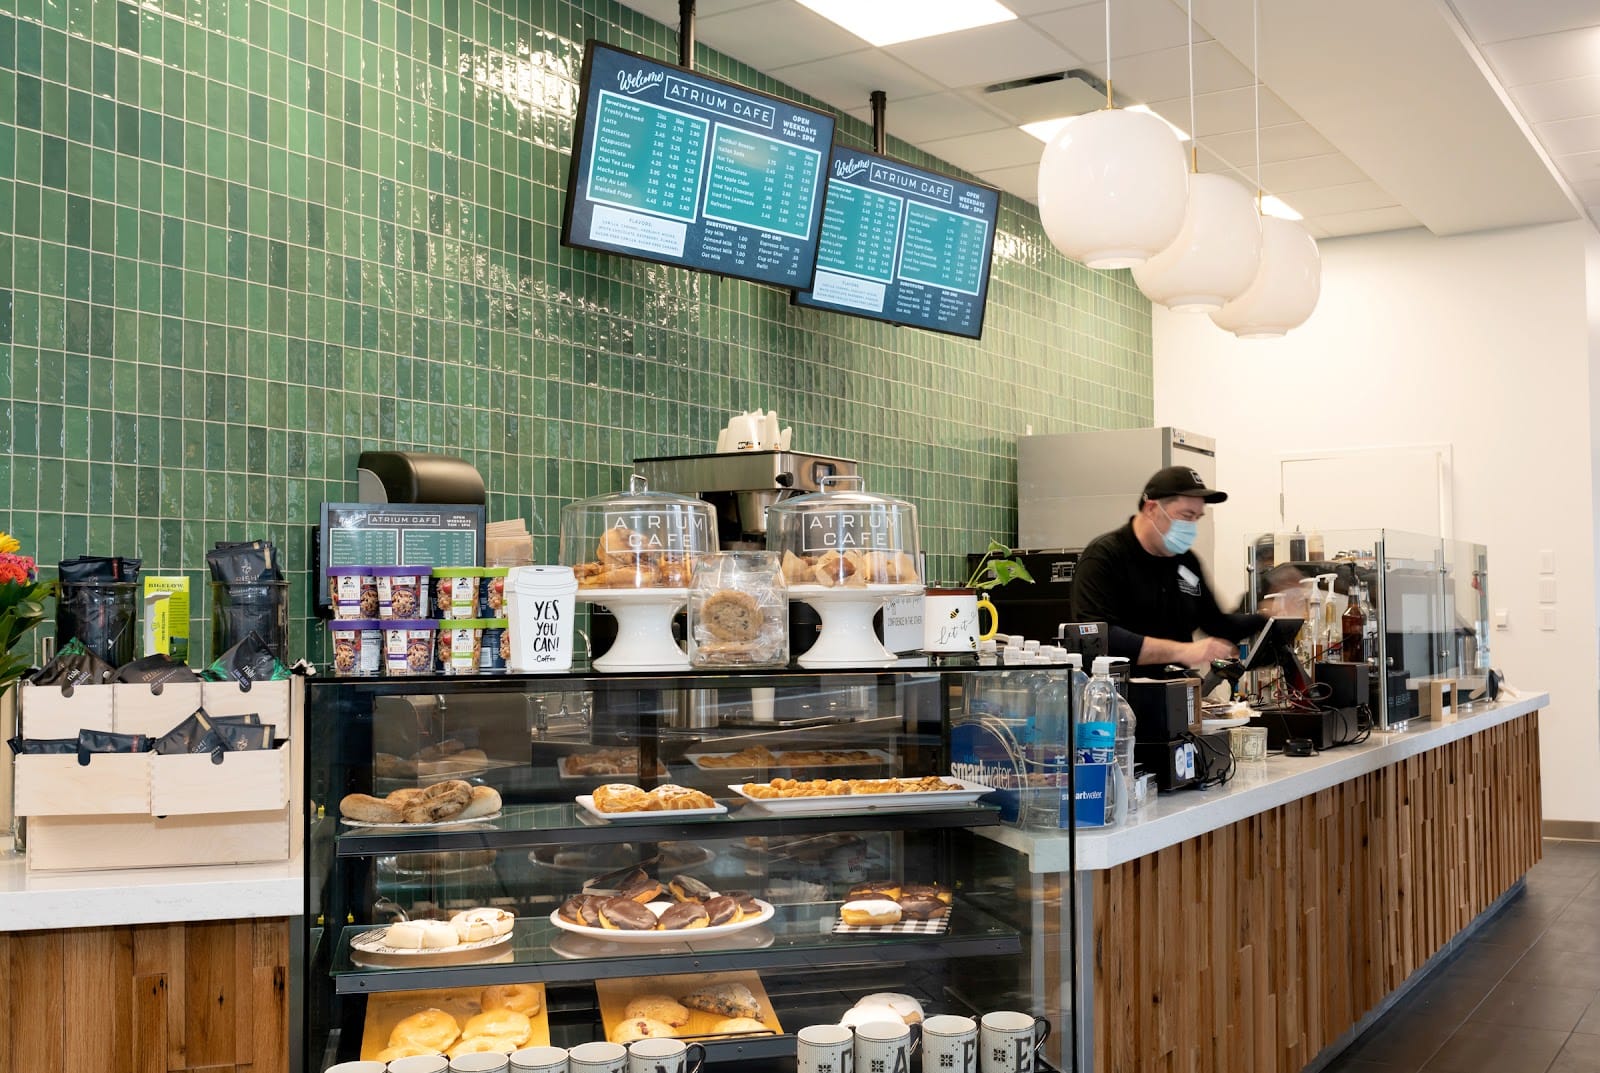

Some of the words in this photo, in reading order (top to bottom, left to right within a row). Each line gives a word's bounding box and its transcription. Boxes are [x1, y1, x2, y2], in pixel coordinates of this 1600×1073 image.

[617, 70, 664, 94] Welcome
[670, 84, 727, 110] ATRIUM
[733, 97, 770, 122] CAFE
[603, 117, 616, 125] Latte
[604, 107, 623, 118] Freshly
[624, 112, 644, 123] Brewed
[793, 115, 809, 125] OPEN
[601, 127, 629, 138] Americano
[783, 120, 817, 136] WEEKDAYS
[600, 136, 631, 149] Cappuccino
[783, 129, 797, 138] 7AM
[802, 134, 815, 143] 5PM
[599, 146, 626, 157] Macchiato
[596, 165, 614, 174] Mocha
[621, 161, 635, 169] Latte
[835, 158, 870, 180] Welcome
[874, 170, 917, 189] ATRIUM
[921, 182, 949, 198] CAFE
[959, 196, 985, 208] WEEKDAYS
[966, 191, 980, 199] OPEN
[614, 515, 703, 530] ATRIUM
[810, 514, 898, 529] ATRIUM
[628, 534, 694, 548] CAFE
[824, 532, 888, 546] CAFE
[534, 600, 559, 621] YES
[536, 622, 558, 636] YOU
[935, 625, 958, 644] Let
[534, 637, 560, 652] CAN!
[950, 760, 1012, 790] smartwater
[1014, 1036, 1032, 1073] E
